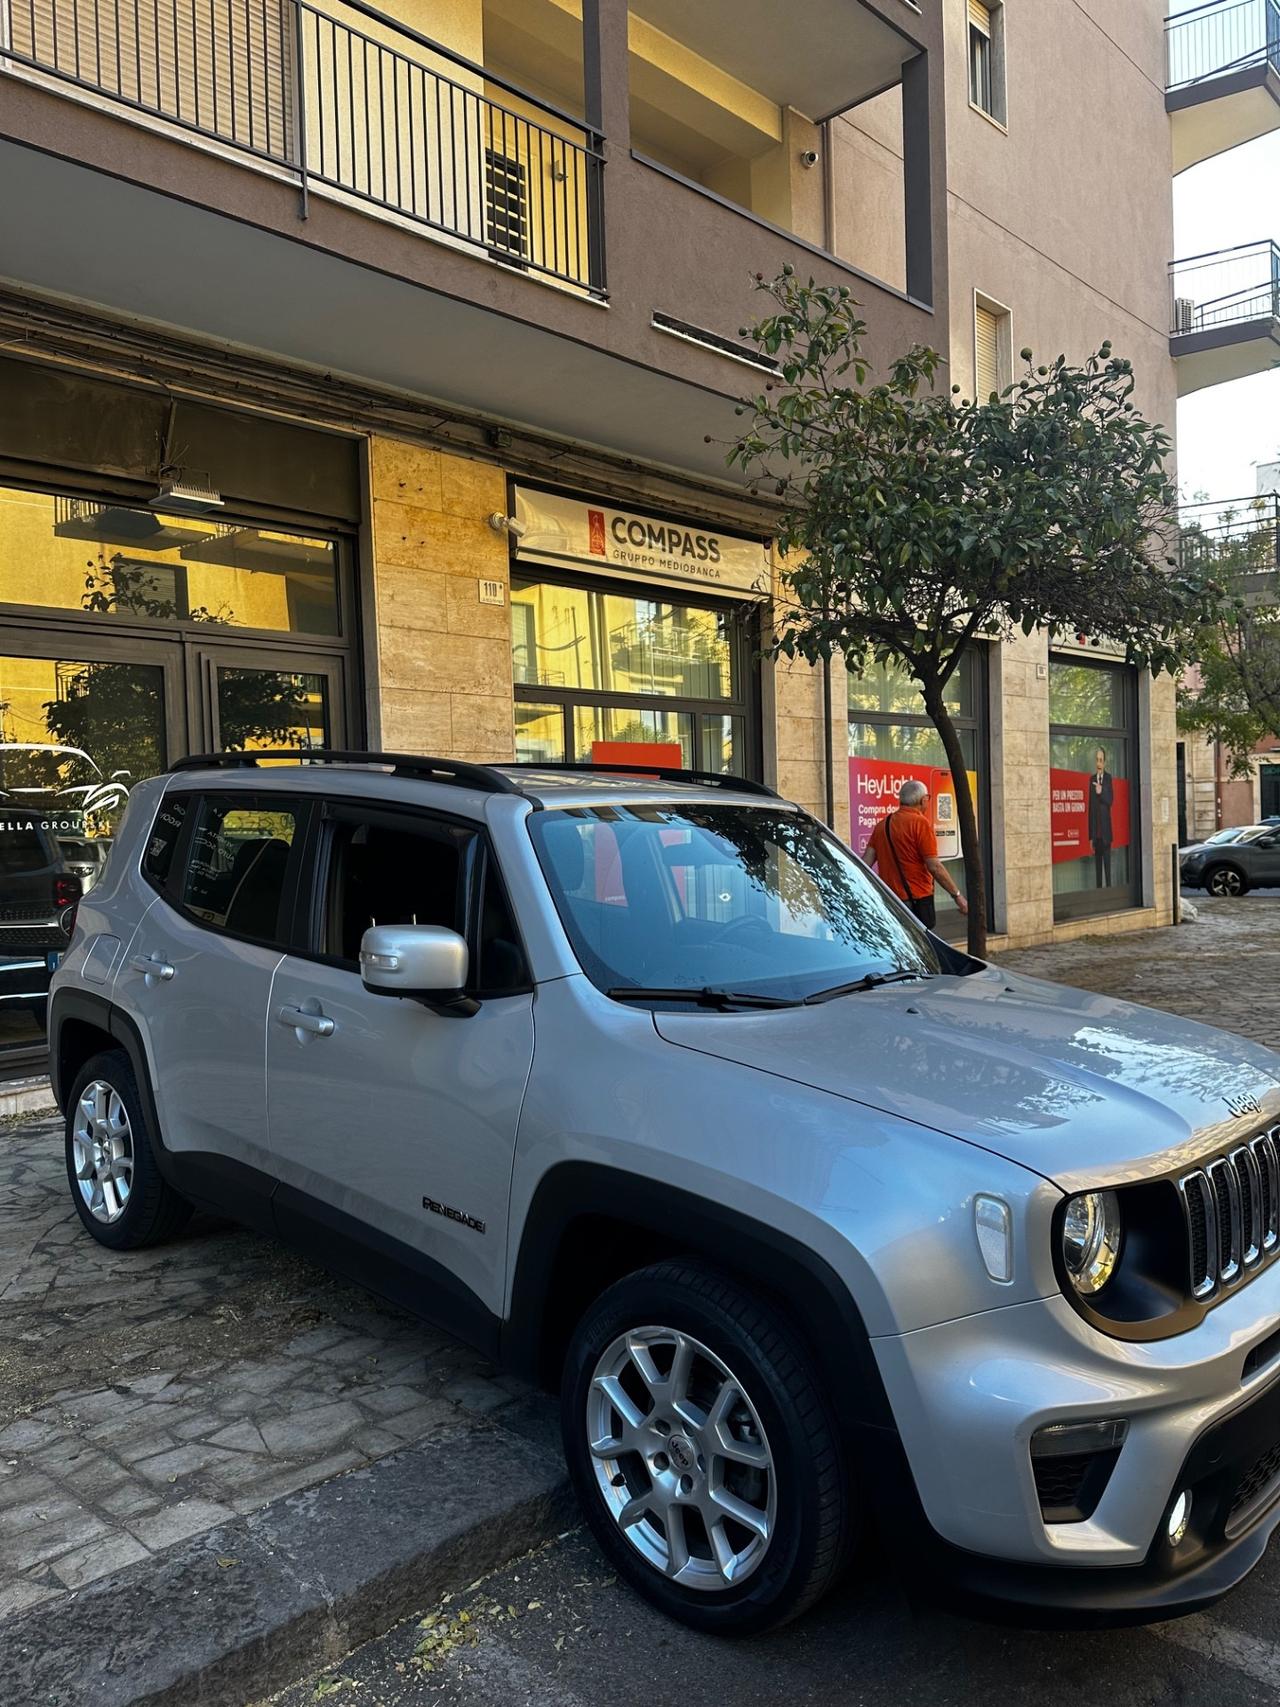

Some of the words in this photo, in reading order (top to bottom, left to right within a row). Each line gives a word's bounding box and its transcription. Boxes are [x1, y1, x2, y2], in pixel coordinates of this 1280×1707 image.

[611, 516, 721, 563] COMPASS
[613, 549, 655, 566] GRUPPO
[659, 559, 721, 579] MEDIOBANCA
[857, 774, 913, 799] HeyLig
[858, 804, 886, 815] Compra
[858, 816, 876, 828] Paga
[40, 820, 88, 830] GROUP
[1221, 1092, 1262, 1118] Jeep
[422, 1196, 486, 1235] RENEGADE
[671, 1441, 689, 1466] Jeep
